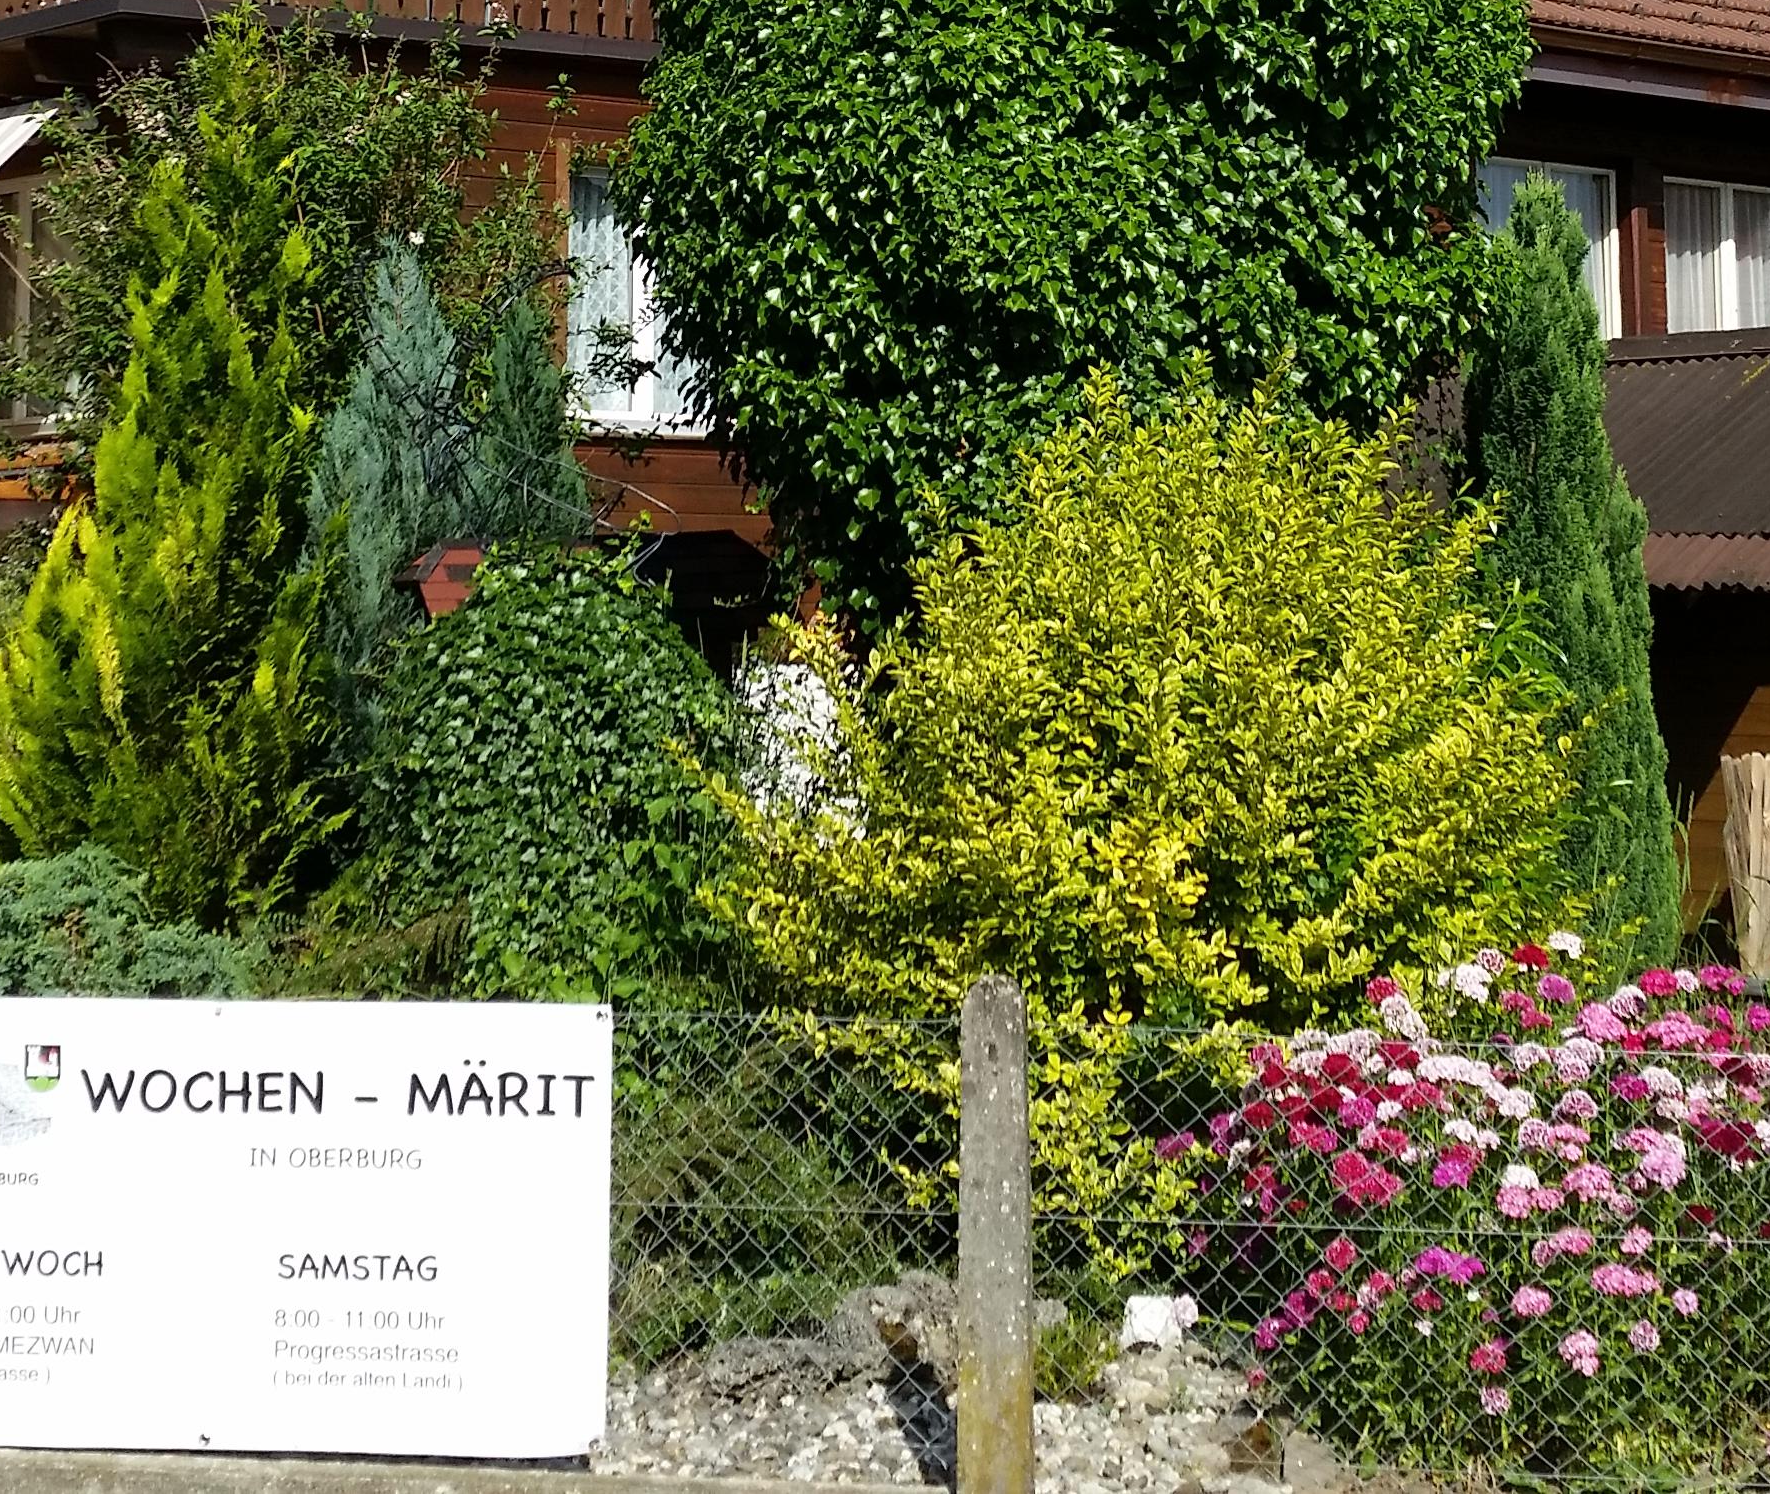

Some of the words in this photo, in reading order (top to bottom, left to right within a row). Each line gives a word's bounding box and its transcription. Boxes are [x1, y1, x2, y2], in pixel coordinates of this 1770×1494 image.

[80, 1068, 324, 1114] WOCHEN
[354, 1095, 379, 1104] -
[407, 1059, 595, 1118] MÄRIT
[249, 1147, 277, 1168] IN
[288, 1147, 423, 1170] OBERBURG
[278, 1253, 438, 1281] SAMSTAG
[44, 1304, 82, 1325] Uhr
[274, 1308, 321, 1328] 8:00
[407, 1310, 446, 1331] Uhr
[274, 1339, 459, 1366] Progressastrasse
[285, 1369, 311, 1386] bei
[317, 1370, 347, 1387] der
[352, 1371, 396, 1387] alten
[402, 1372, 451, 1389] Landi
